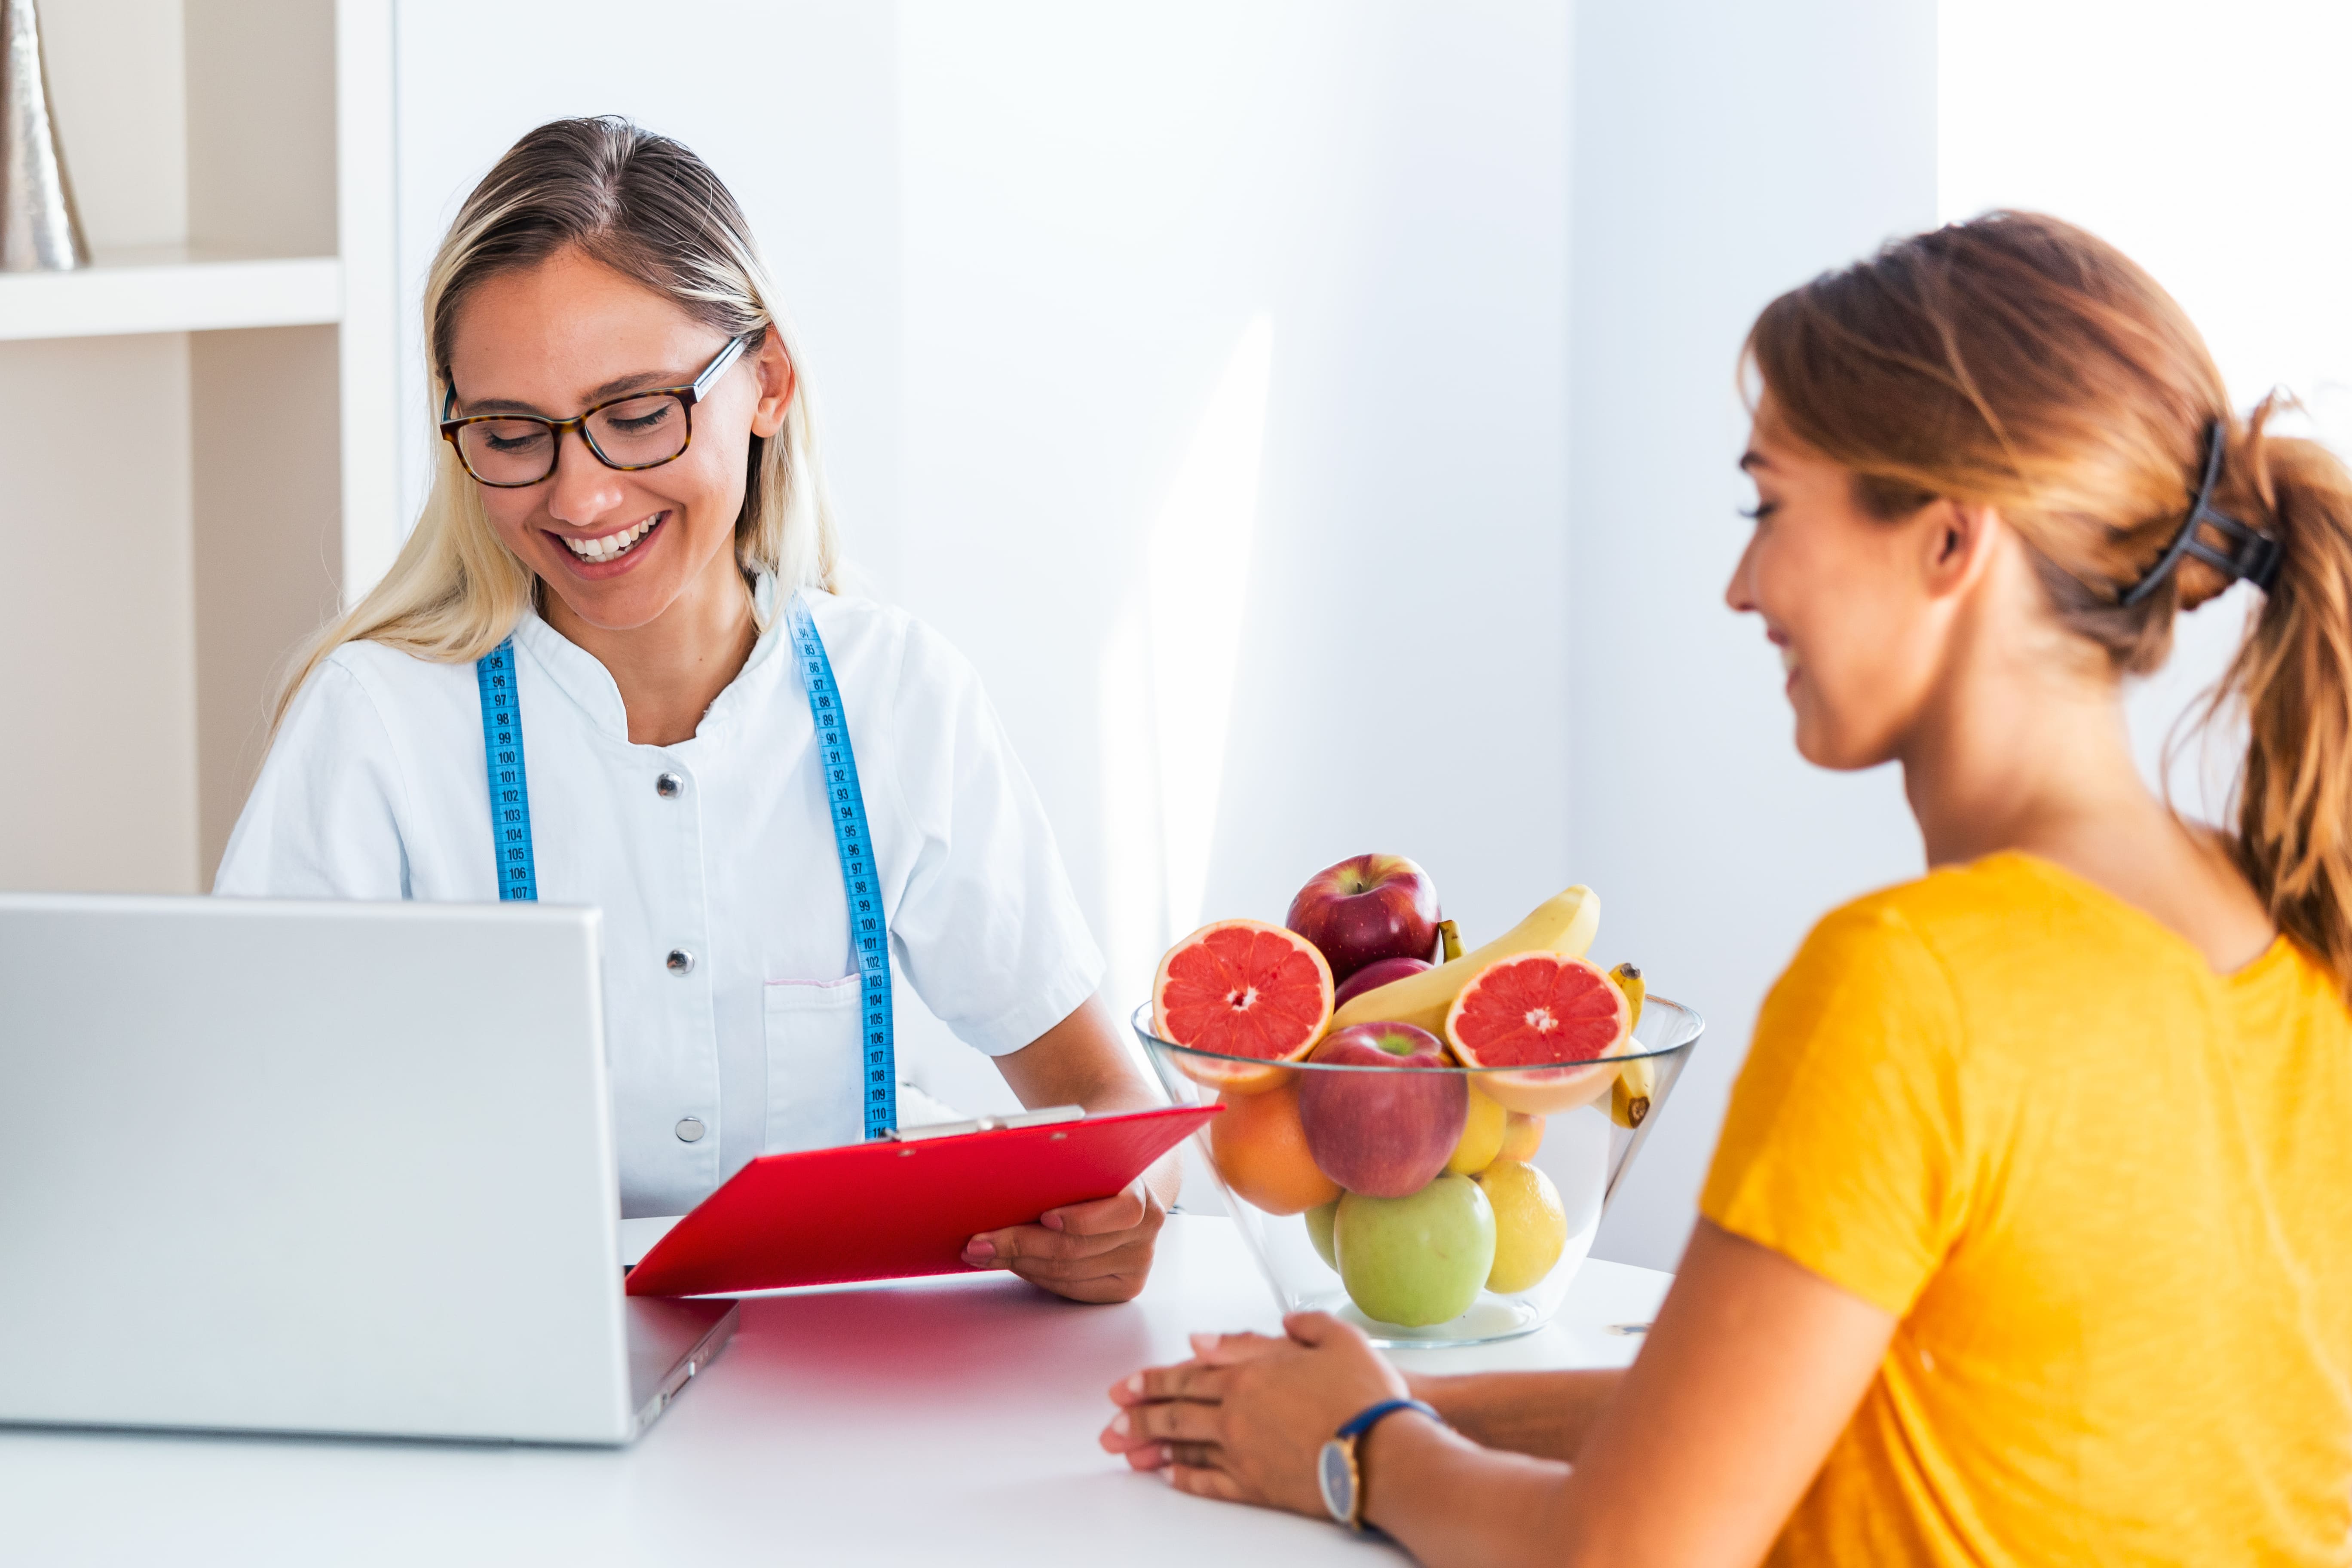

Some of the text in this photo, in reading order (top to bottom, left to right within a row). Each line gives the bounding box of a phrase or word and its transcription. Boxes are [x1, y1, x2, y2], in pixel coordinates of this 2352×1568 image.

[799, 628, 808, 638] 84
[805, 645, 815, 655] 85
[491, 657, 503, 669] 95
[809, 662, 819, 673] 86
[493, 675, 505, 687] 96
[813, 680, 823, 690] 87
[495, 695, 506, 706] 97
[819, 696, 830, 707] 88
[497, 714, 509, 725] 98
[823, 714, 833, 726] 89
[499, 732, 511, 744] 99
[826, 733, 837, 744] 90
[499, 751, 515, 763] 100
[830, 751, 841, 763] 91
[500, 771, 515, 783] 101
[834, 770, 845, 781] 92
[502, 790, 518, 802] 102
[837, 788, 848, 799] 93
[504, 809, 521, 821] 103
[841, 807, 852, 818] 94
[506, 828, 522, 841] 104
[845, 825, 856, 837] 95
[508, 848, 524, 860] 105
[848, 844, 859, 855] 96
[509, 867, 526, 879] 106
[852, 863, 862, 874] 97
[511, 887, 527, 899] 107
[855, 882, 867, 893] 98
[859, 900, 870, 911] 99
[861, 919, 876, 930] 100
[864, 938, 876, 949] 101
[866, 956, 880, 968] 102
[869, 975, 882, 987] 103
[870, 994, 882, 1006] 104
[870, 1013, 883, 1025] 105
[870, 1032, 883, 1044] 106
[871, 1051, 883, 1063] 107
[871, 1070, 885, 1082] 108
[871, 1089, 885, 1101] 109
[872, 1108, 886, 1120] 110
[873, 1127, 886, 1138] 11
